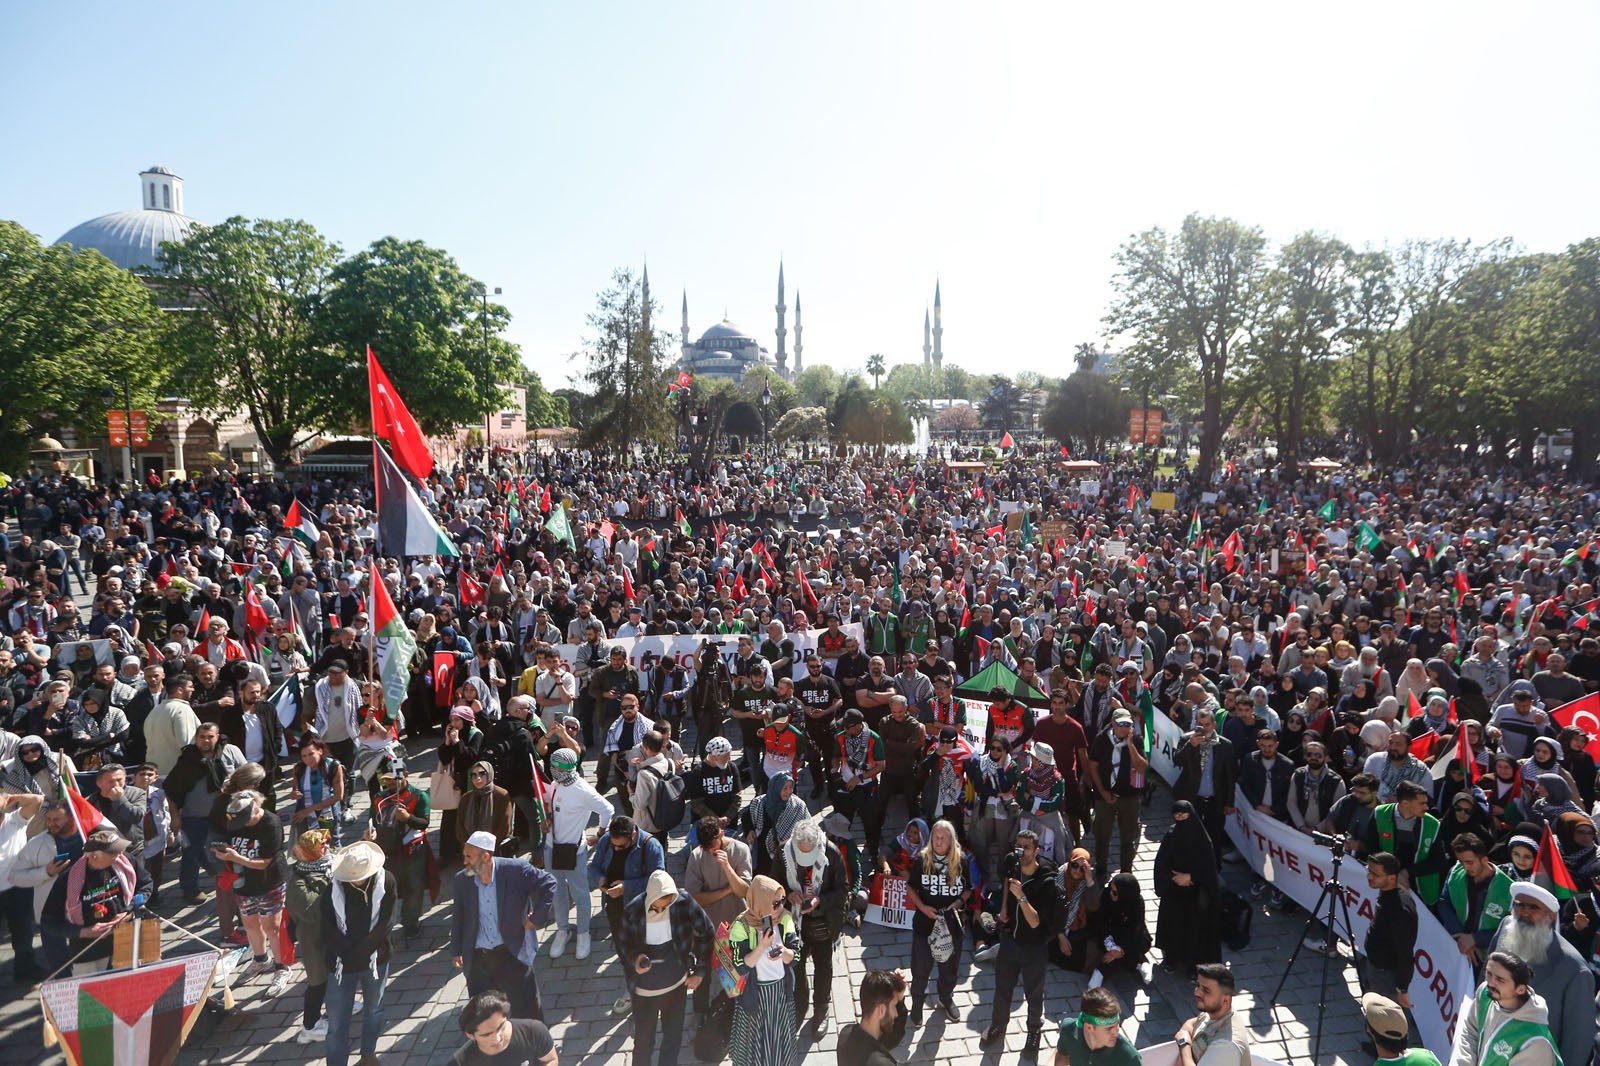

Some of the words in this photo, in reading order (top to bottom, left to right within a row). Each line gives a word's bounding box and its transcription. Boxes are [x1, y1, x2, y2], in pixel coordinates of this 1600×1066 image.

[965, 701, 982, 710] PEN
[883, 878, 907, 892] CEASE
[921, 874, 963, 886] BREK
[930, 885, 964, 896] SIEGE
[882, 890, 907, 909] FIRE
[881, 907, 906, 925] NOW!
[1252, 830, 1302, 874] THE
[1308, 863, 1375, 920] RFA
[1414, 948, 1459, 1047] ORDE
